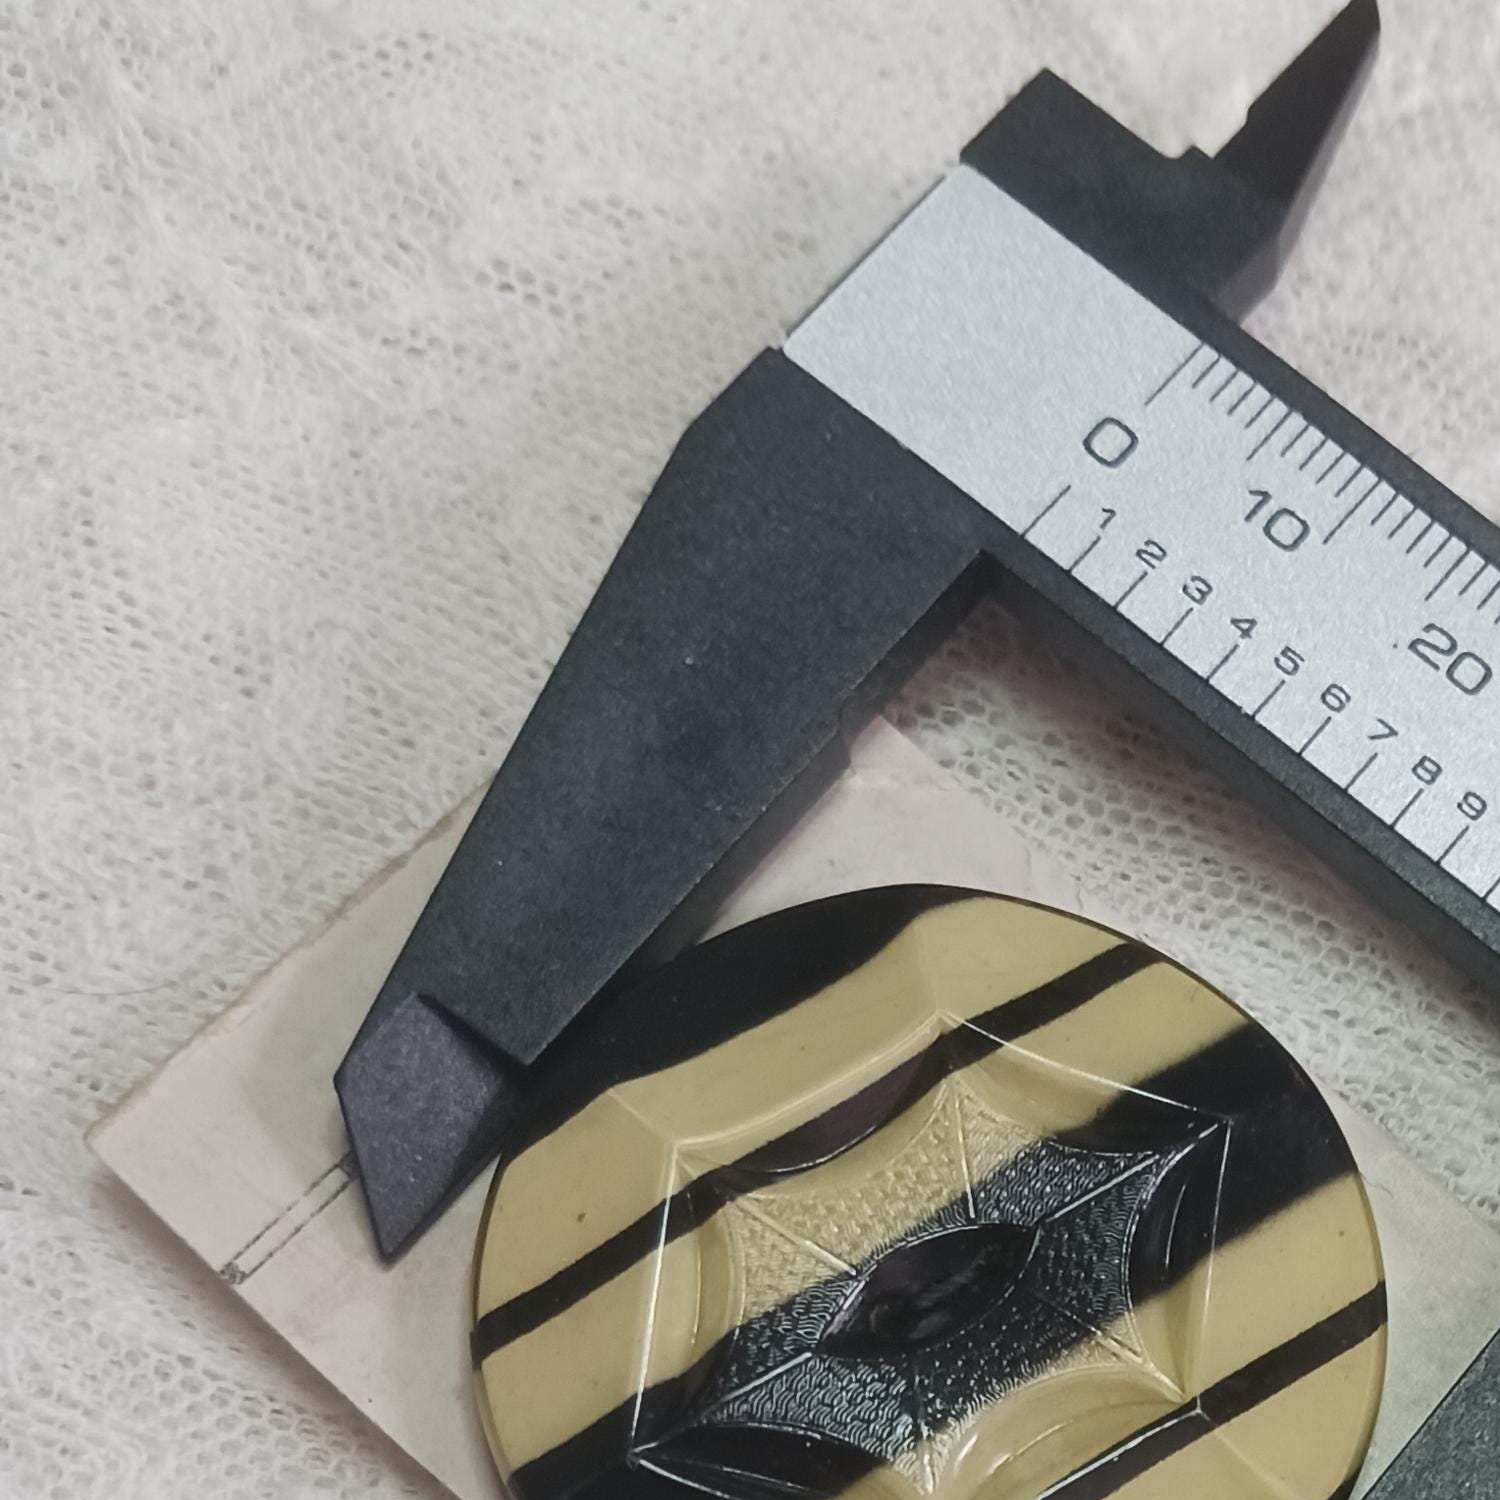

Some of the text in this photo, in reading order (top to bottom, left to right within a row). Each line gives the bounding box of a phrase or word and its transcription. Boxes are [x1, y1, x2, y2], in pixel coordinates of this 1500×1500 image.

[1082, 416, 1139, 468] 0
[1244, 489, 1310, 552] 10
[1407, 622, 1493, 696] 20
[1099, 507, 1116, 529] 1
[1135, 539, 1167, 570] 2
[1182, 575, 1213, 605] 3
[1230, 618, 1258, 639] 4
[1273, 645, 1305, 676] 5
[1320, 683, 1352, 713] 6
[1367, 718, 1399, 741] 7
[1411, 755, 1443, 786] 8
[1456, 791, 1488, 821] 9
